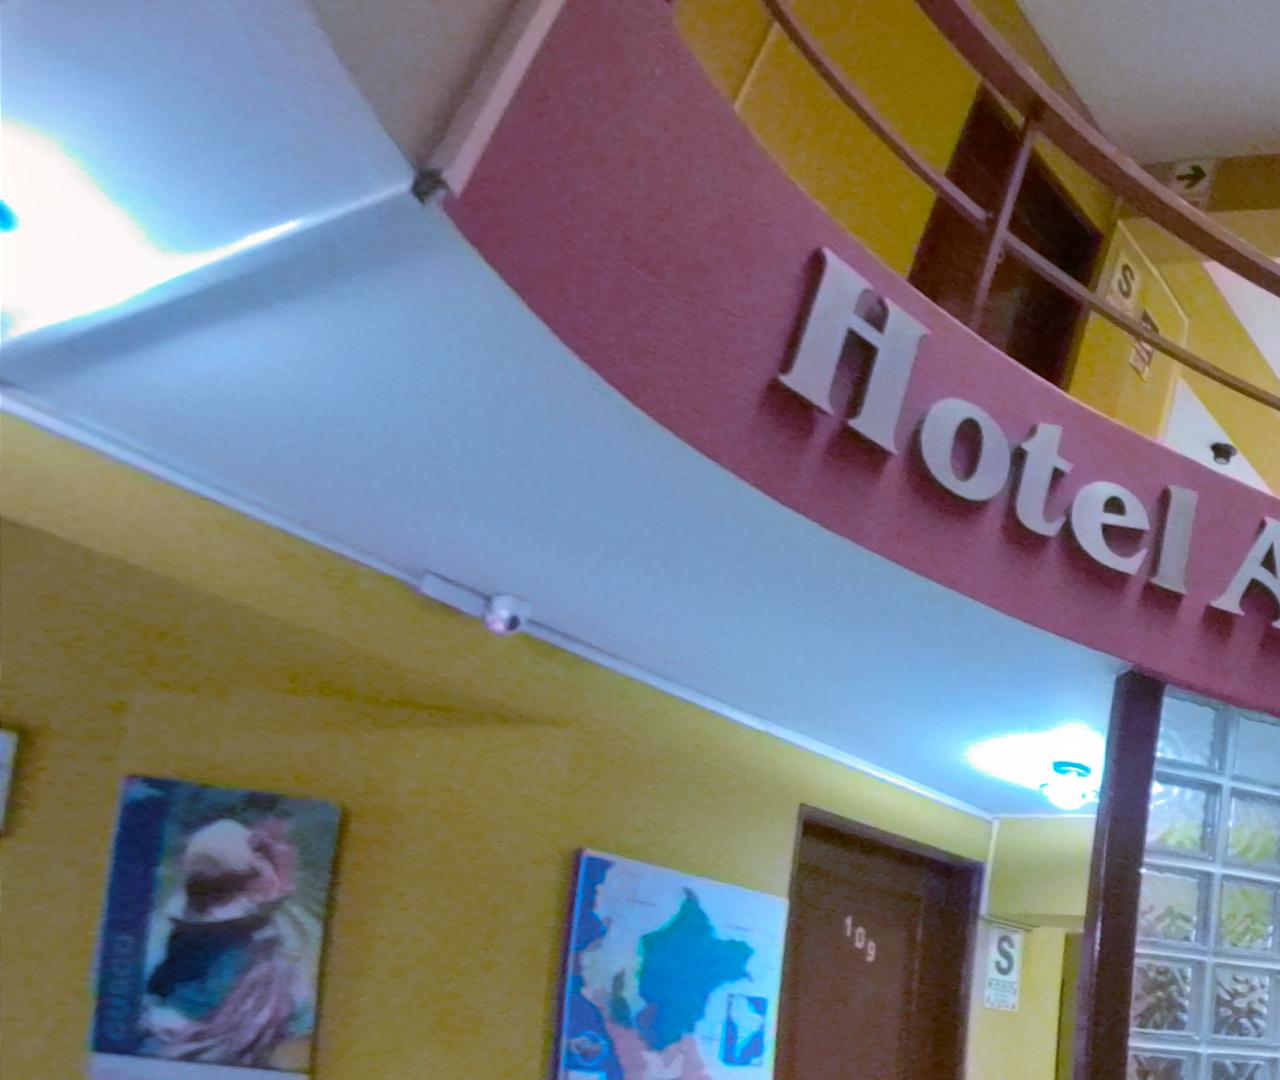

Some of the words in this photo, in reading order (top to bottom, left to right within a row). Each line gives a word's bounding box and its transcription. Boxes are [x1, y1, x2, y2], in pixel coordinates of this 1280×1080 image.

[1118, 263, 1135, 299] S
[778, 247, 1198, 595] Hotel
[845, 914, 876, 963] 109
[995, 934, 1015, 976] S
